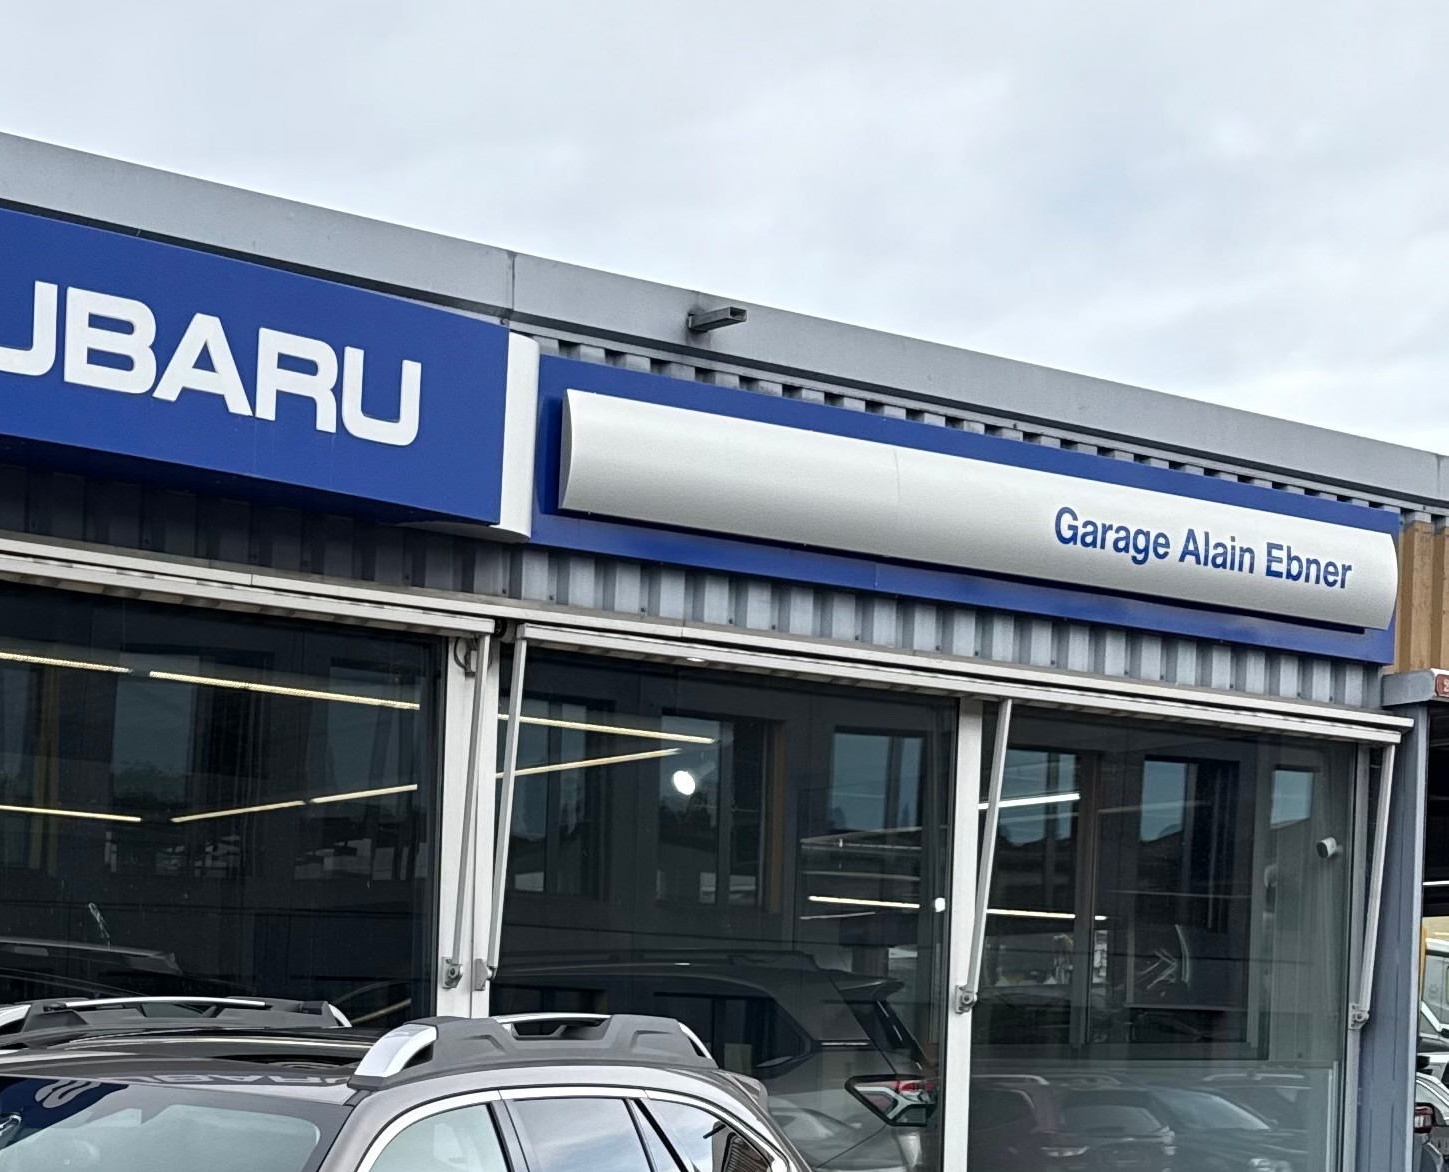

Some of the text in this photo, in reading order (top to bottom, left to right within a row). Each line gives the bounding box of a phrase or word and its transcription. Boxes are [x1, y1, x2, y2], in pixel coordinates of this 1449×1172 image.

[1054, 506, 1353, 589] Garage Alain Ebner
